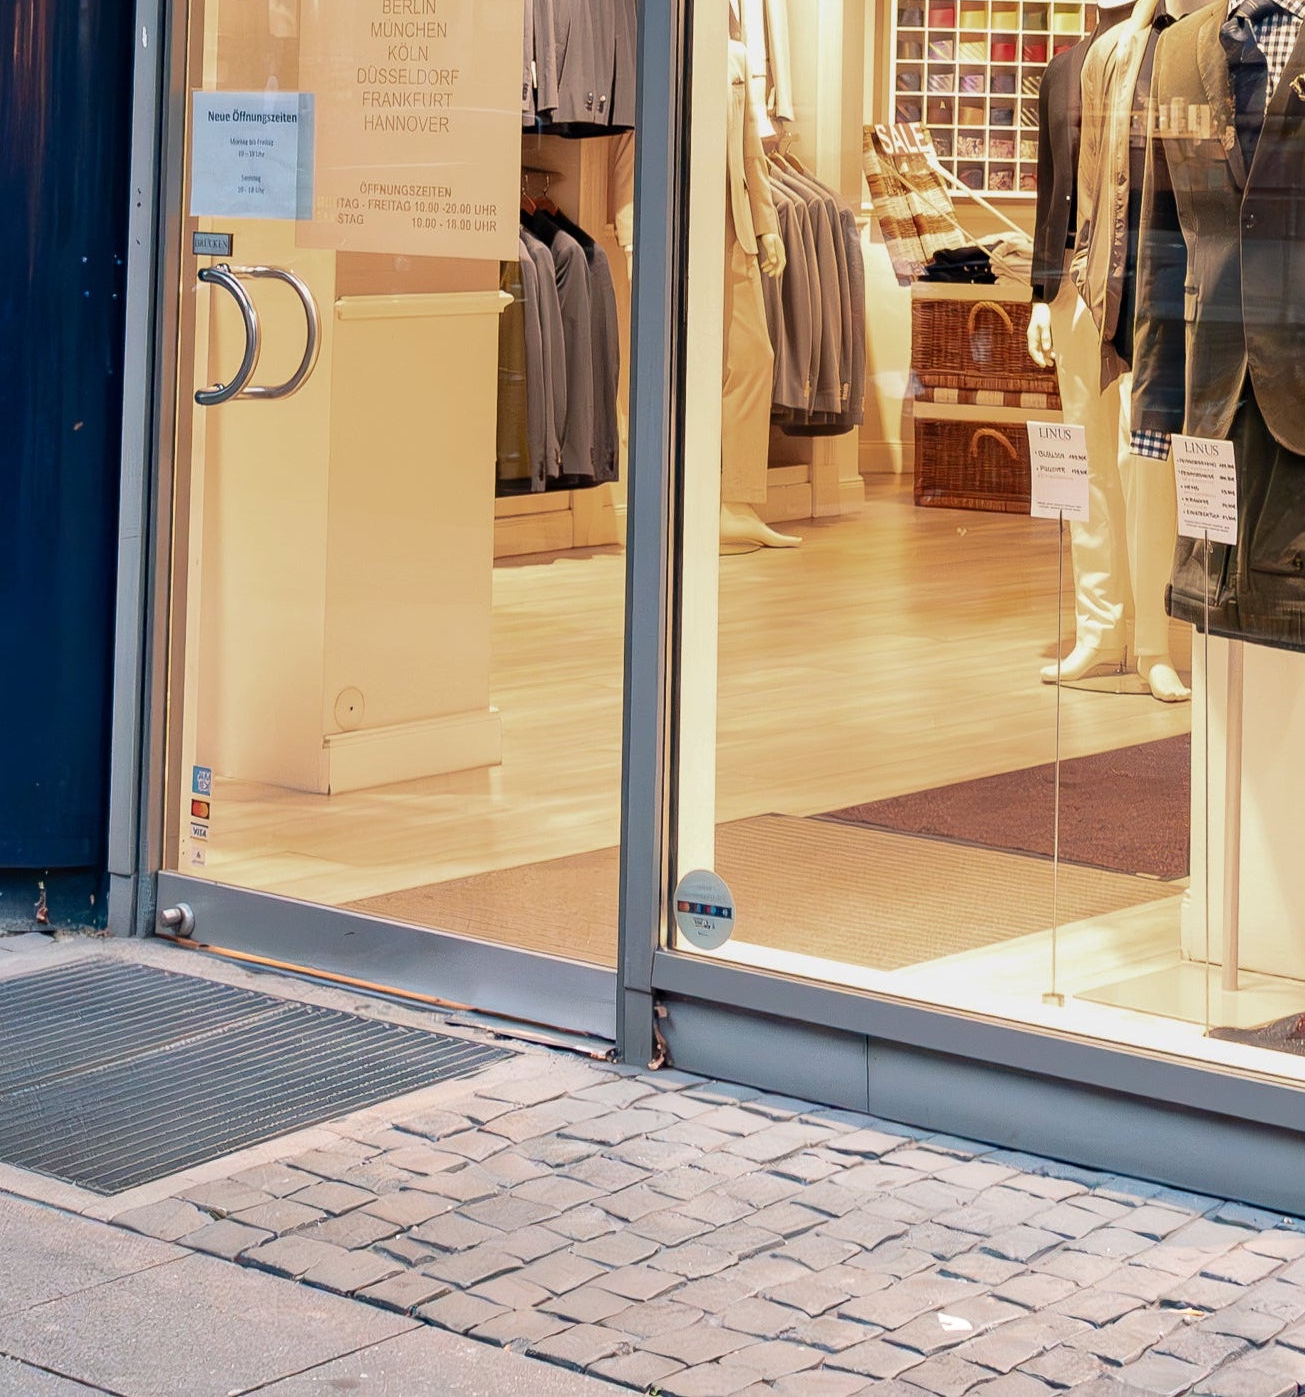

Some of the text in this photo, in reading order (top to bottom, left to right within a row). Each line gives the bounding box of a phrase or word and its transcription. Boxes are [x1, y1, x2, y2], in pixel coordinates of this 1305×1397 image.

[371, 19, 447, 38] MÜNCHEN
[388, 42, 429, 62] KÖLN
[357, 66, 460, 86] DÜSSELDORF
[362, 91, 453, 108] FRANKFURT
[207, 108, 298, 125] Neue Öffnungszeiten
[364, 115, 449, 133] HANNOVER
[874, 121, 930, 155] SALE
[359, 180, 452, 199] ÖFFNUNGSZEITEN
[368, 199, 412, 213] FREITAG
[415, 201, 442, 215] 10.00
[474, 204, 497, 217] UHR
[412, 216, 437, 230] 10.00
[474, 219, 497, 232] UHR
[1039, 427, 1072, 440] LINUS
[1185, 441, 1220, 455] LINUS
